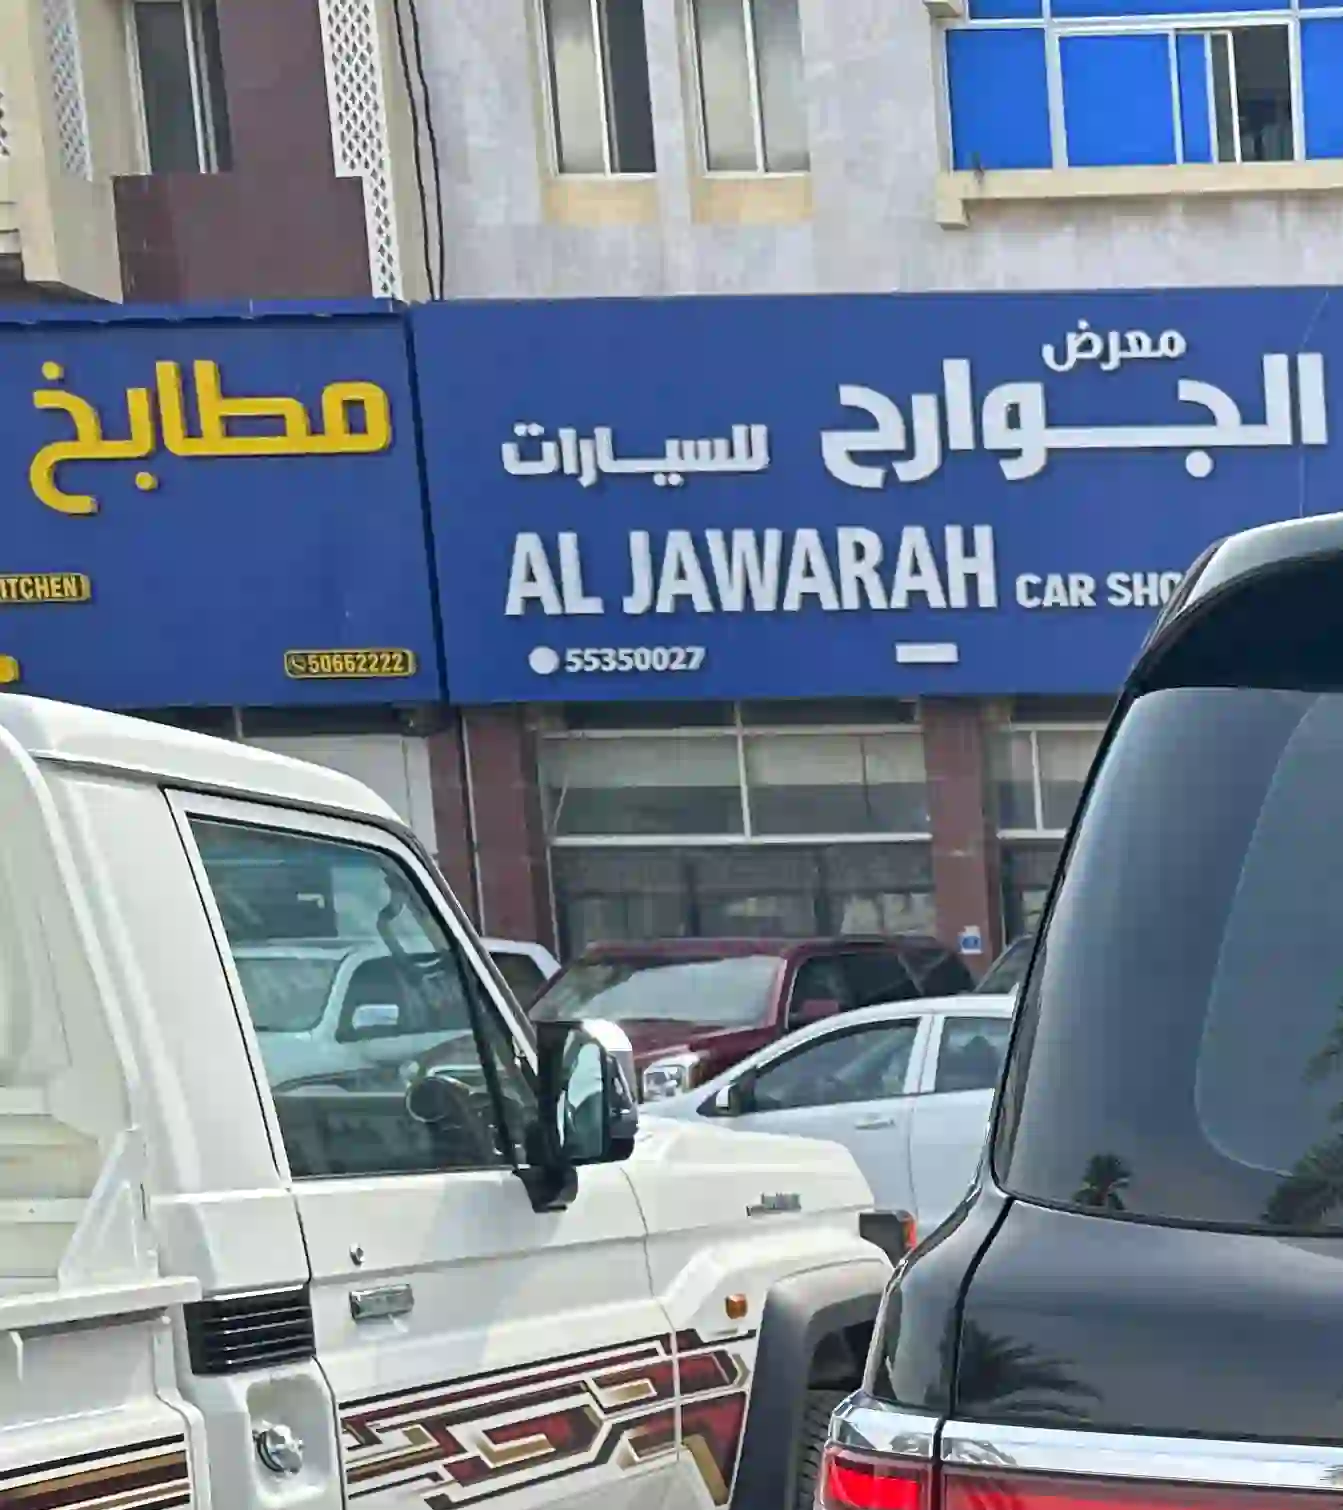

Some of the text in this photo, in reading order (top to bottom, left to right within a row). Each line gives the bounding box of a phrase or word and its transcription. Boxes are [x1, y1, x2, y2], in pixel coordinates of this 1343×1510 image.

[1041, 319, 1186, 372] معرض
[29, 359, 392, 515] مطابخ
[501, 351, 1329, 489] الجوارح للسيارات
[0, 576, 78, 600] ITCHEN
[504, 524, 1183, 616] AL JAWARAH CAR SHO
[307, 653, 404, 674] 50662222
[565, 646, 706, 673] 55350027
